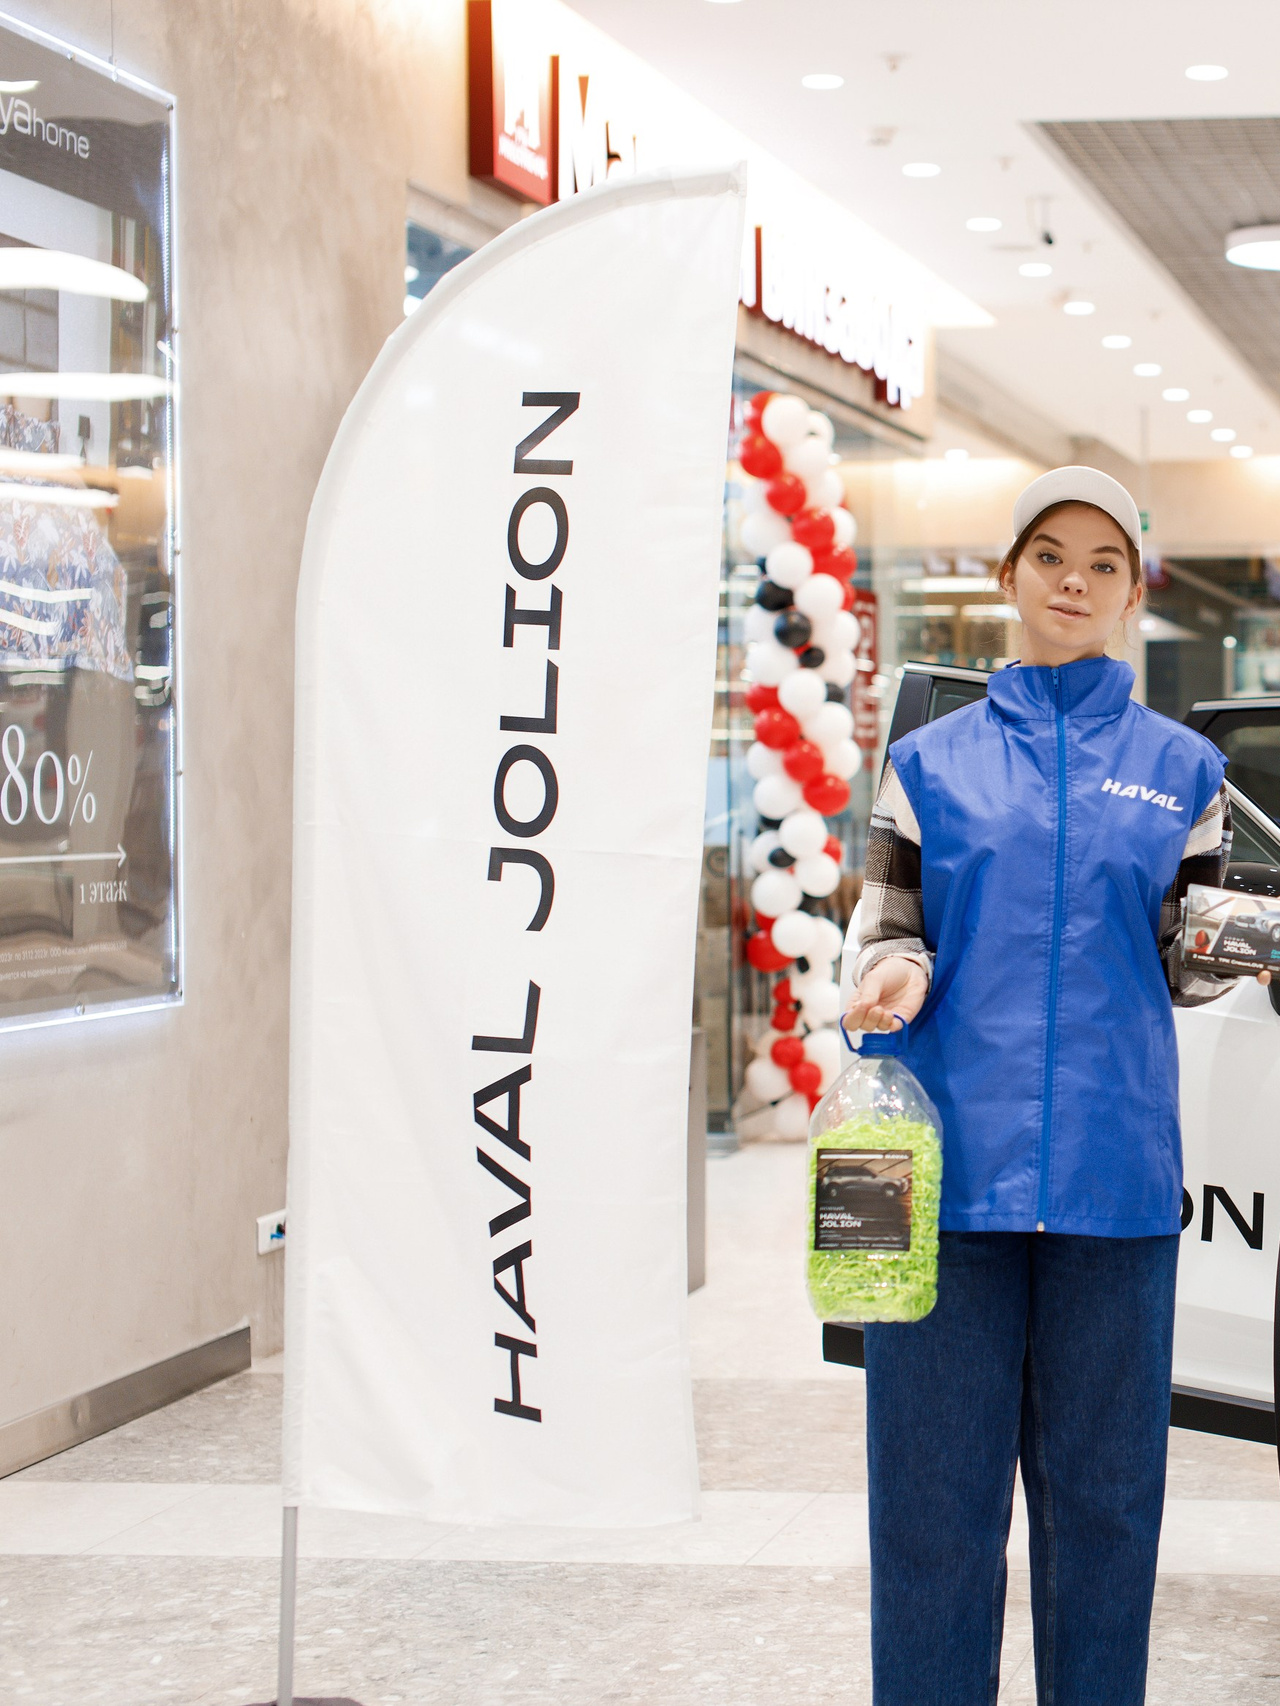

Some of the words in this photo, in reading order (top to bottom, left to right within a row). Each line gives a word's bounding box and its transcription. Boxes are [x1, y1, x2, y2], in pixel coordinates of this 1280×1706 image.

[488, 391, 581, 932] JOLION
[0, 724, 97, 826] 80%
[1101, 778, 1184, 812] HAVAL
[80, 883, 86, 905] 1
[89, 879, 128, 904] этаж
[472, 979, 542, 1423] HAVAL
[819, 1220, 862, 1228] JOLION
